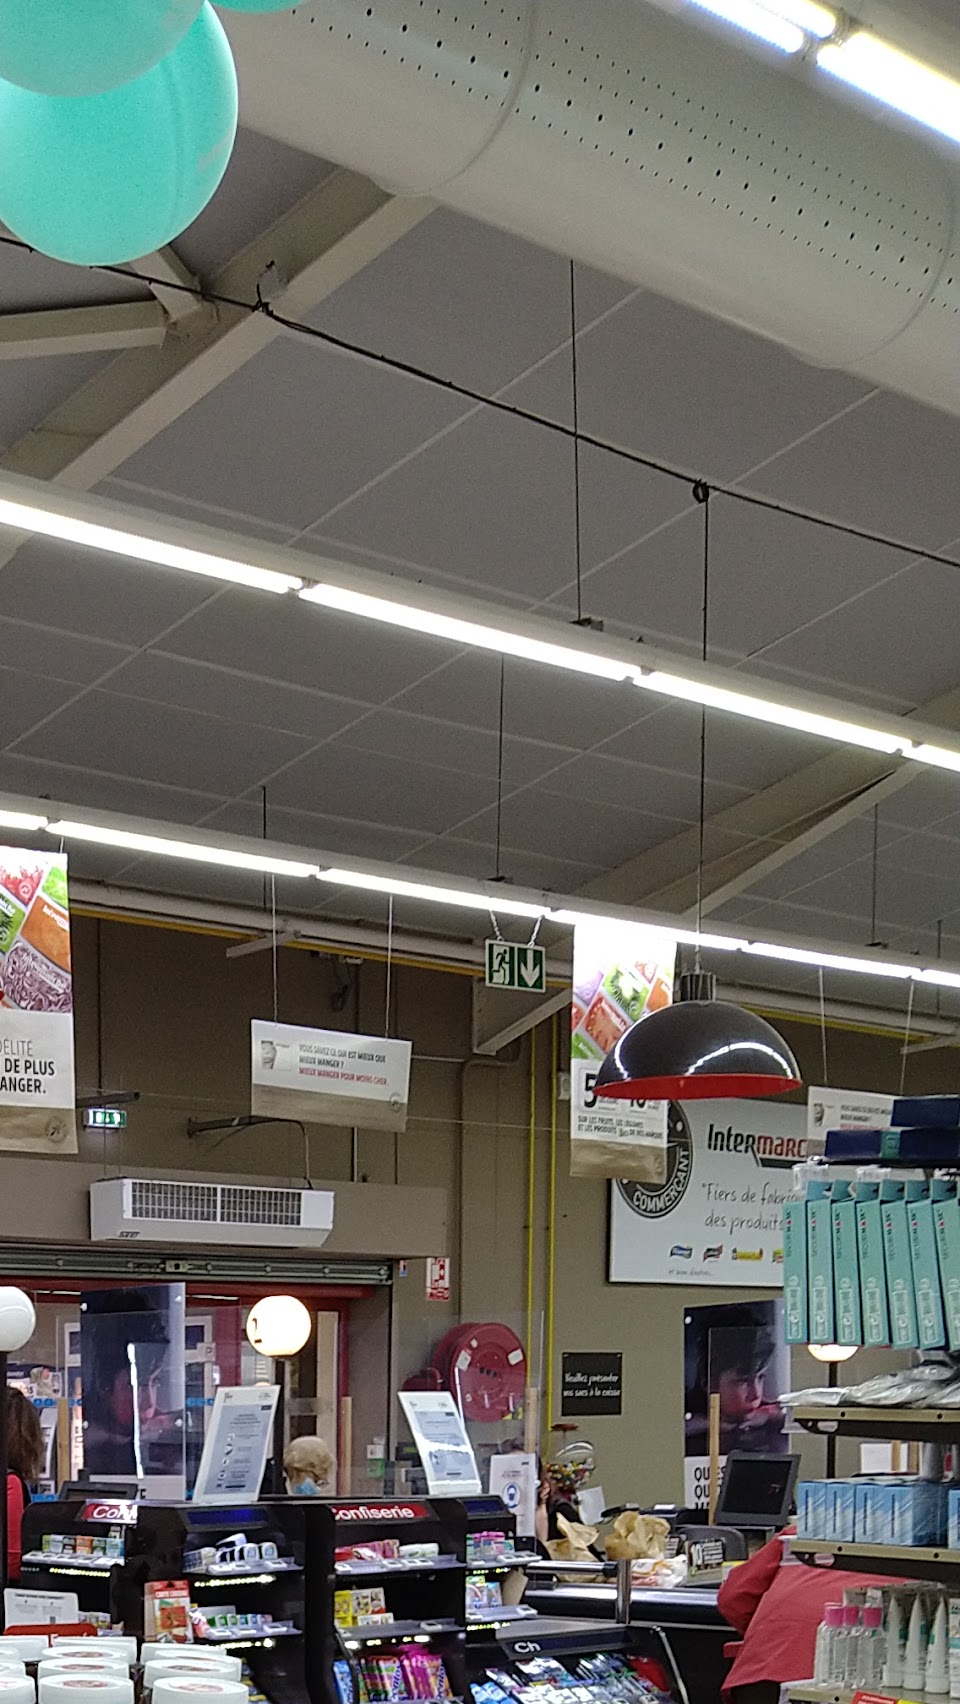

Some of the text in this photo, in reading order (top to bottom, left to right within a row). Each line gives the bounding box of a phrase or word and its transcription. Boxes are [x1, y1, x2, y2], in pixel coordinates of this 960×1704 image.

[4, 1058, 20, 1074] DE
[24, 1060, 55, 1077] PLUS
[632, 1147, 690, 1213] COMMERÇANT
[741, 1184, 757, 1203] de
[705, 1208, 727, 1228] des
